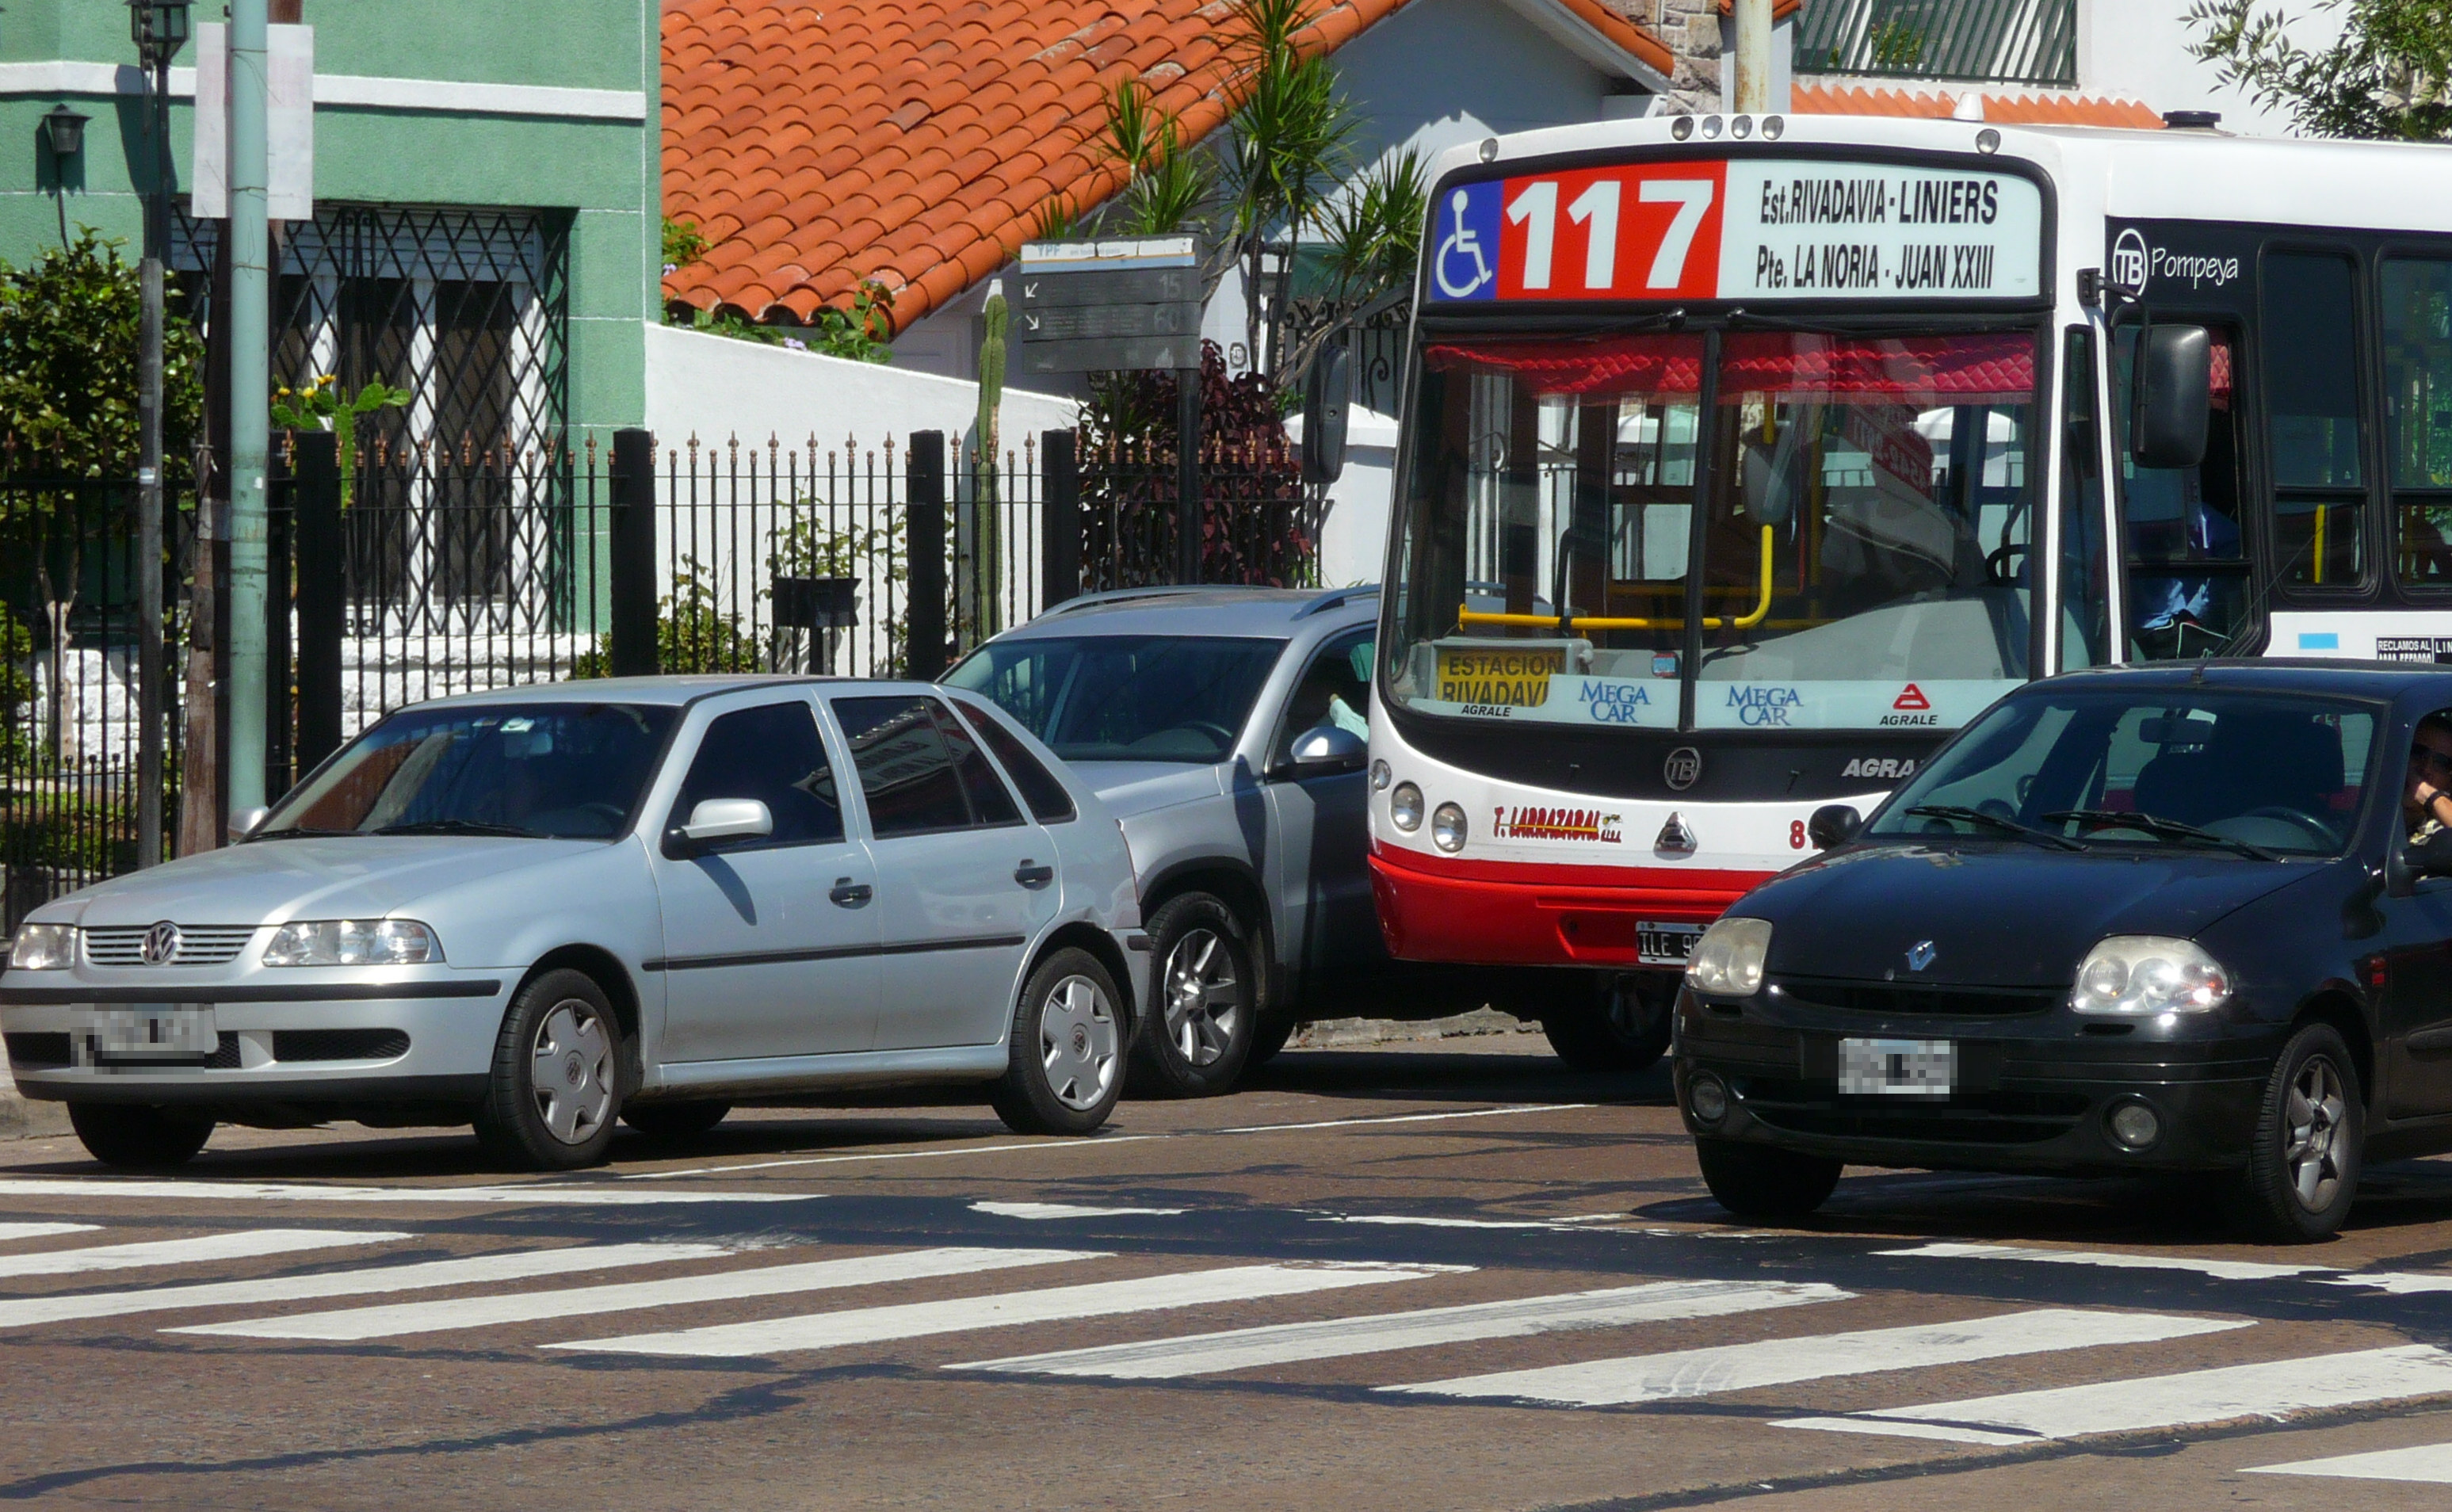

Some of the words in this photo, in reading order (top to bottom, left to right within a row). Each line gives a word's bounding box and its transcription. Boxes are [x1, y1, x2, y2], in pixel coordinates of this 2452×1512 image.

[1899, 180, 1998, 225] LINIERS
[1507, 179, 1713, 288] 117
[1755, 245, 1787, 288] Pte.
[1793, 245, 1815, 288] LA
[1820, 244, 1878, 288] NORIA
[1896, 245, 1947, 288] JUAN
[1950, 245, 1994, 288] XXIII
[2152, 247, 2238, 289] Pompeya
[2378, 640, 2420, 651] RECLAMOS
[2420, 640, 2431, 651] AL
[1449, 655, 1564, 676] ESTACION
[1579, 681, 1651, 705] MEGA
[1725, 685, 1804, 708] MEGA
[1461, 704, 1511, 717] AGRALE
[1590, 701, 1638, 724] CAR
[1739, 704, 1791, 726] CAR
[1879, 715, 1938, 726] AGRALE
[1639, 933, 1672, 956] ILE
